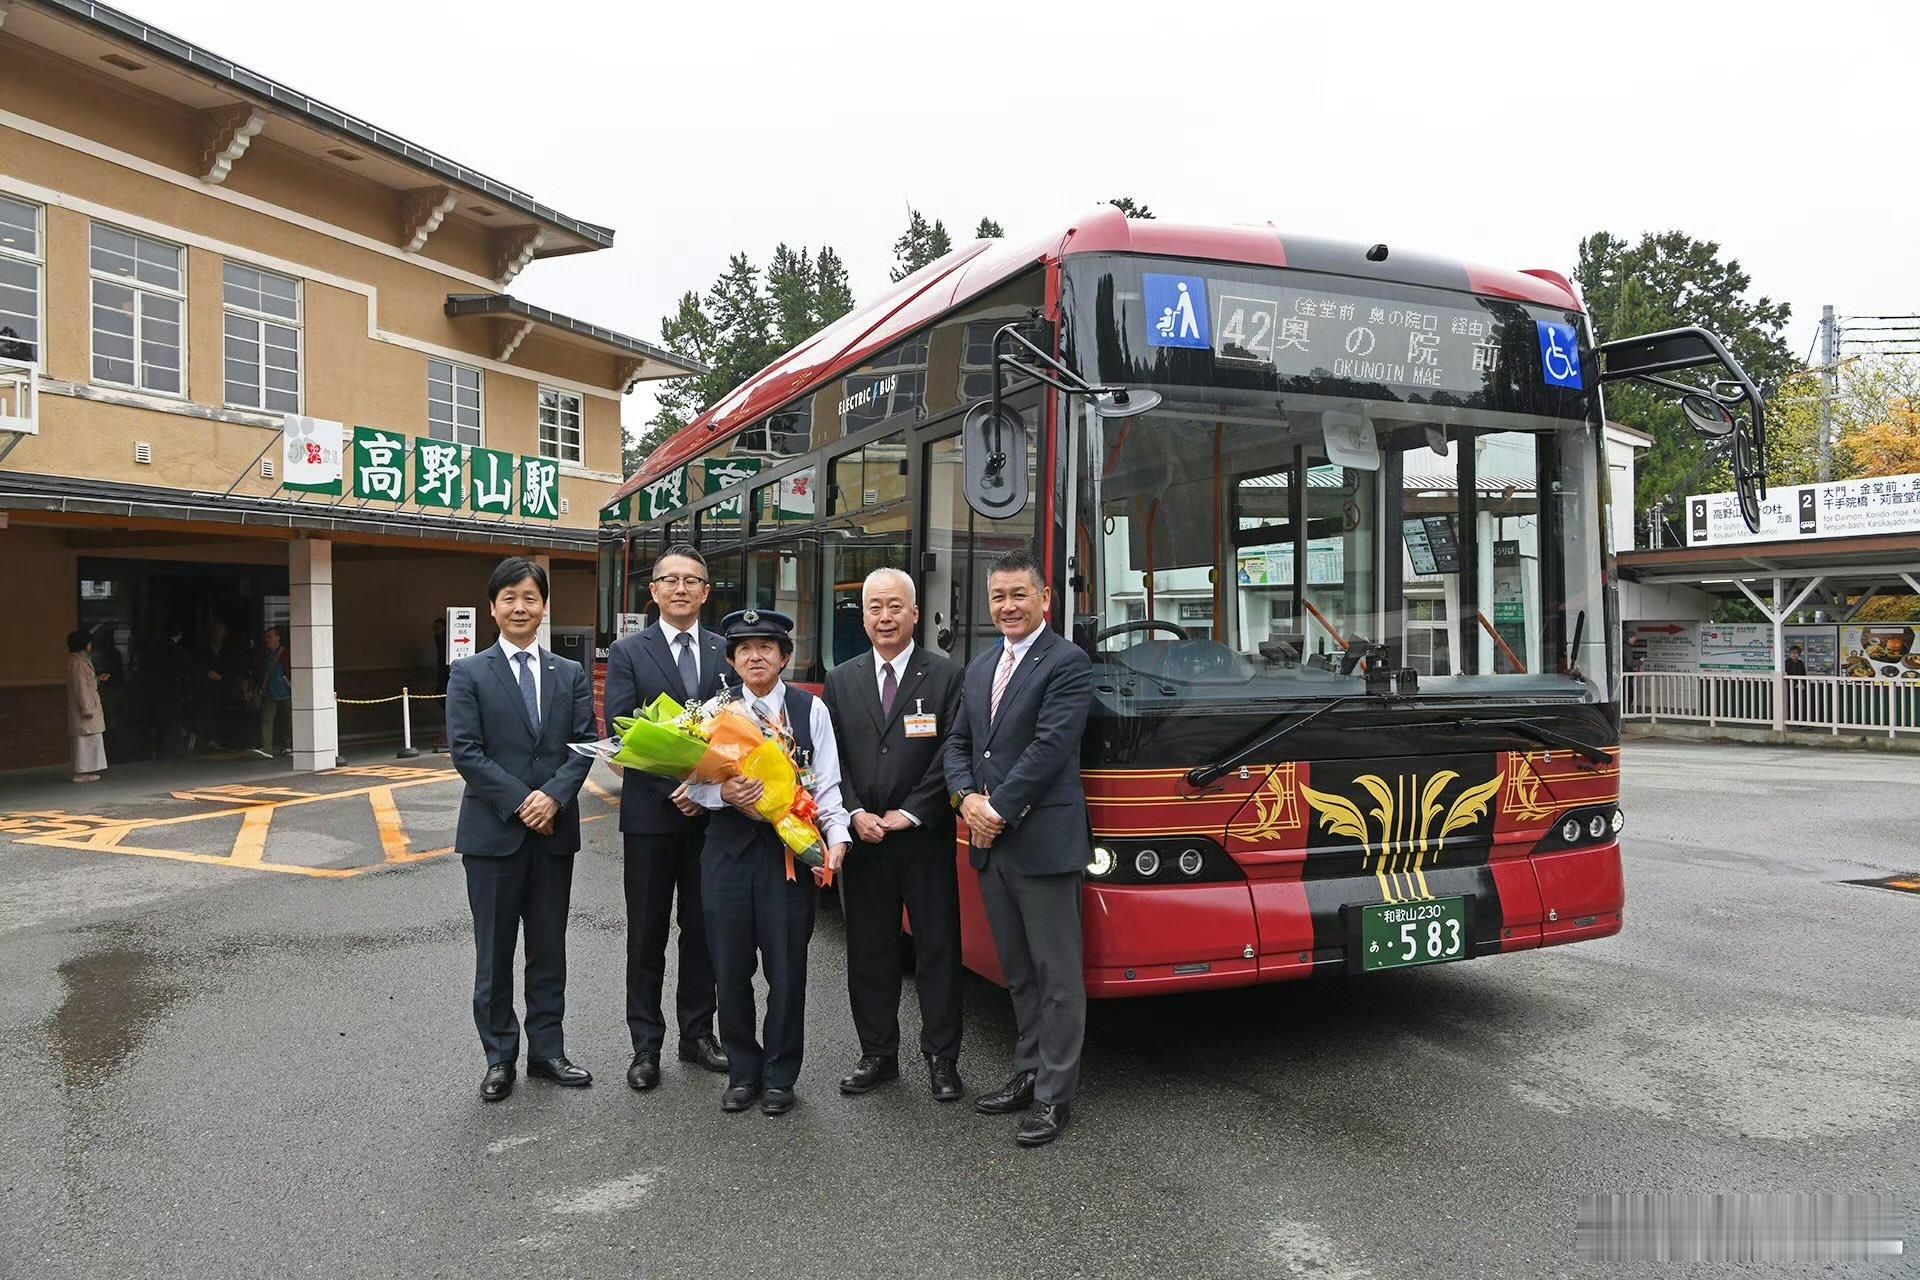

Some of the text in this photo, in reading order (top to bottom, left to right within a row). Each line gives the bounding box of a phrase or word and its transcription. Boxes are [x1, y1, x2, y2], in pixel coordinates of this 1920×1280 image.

[1221, 307, 1272, 354] 42
[1333, 357, 1444, 387] OKUNOIN MAE
[838, 374, 896, 416] ELECTRIC BUS
[358, 431, 560, 517] 高野山駅
[1695, 504, 1704, 518] 3
[1802, 494, 1813, 508] 2
[1384, 904, 1442, 924] 和歌山230
[1369, 940, 1380, 953] あ
